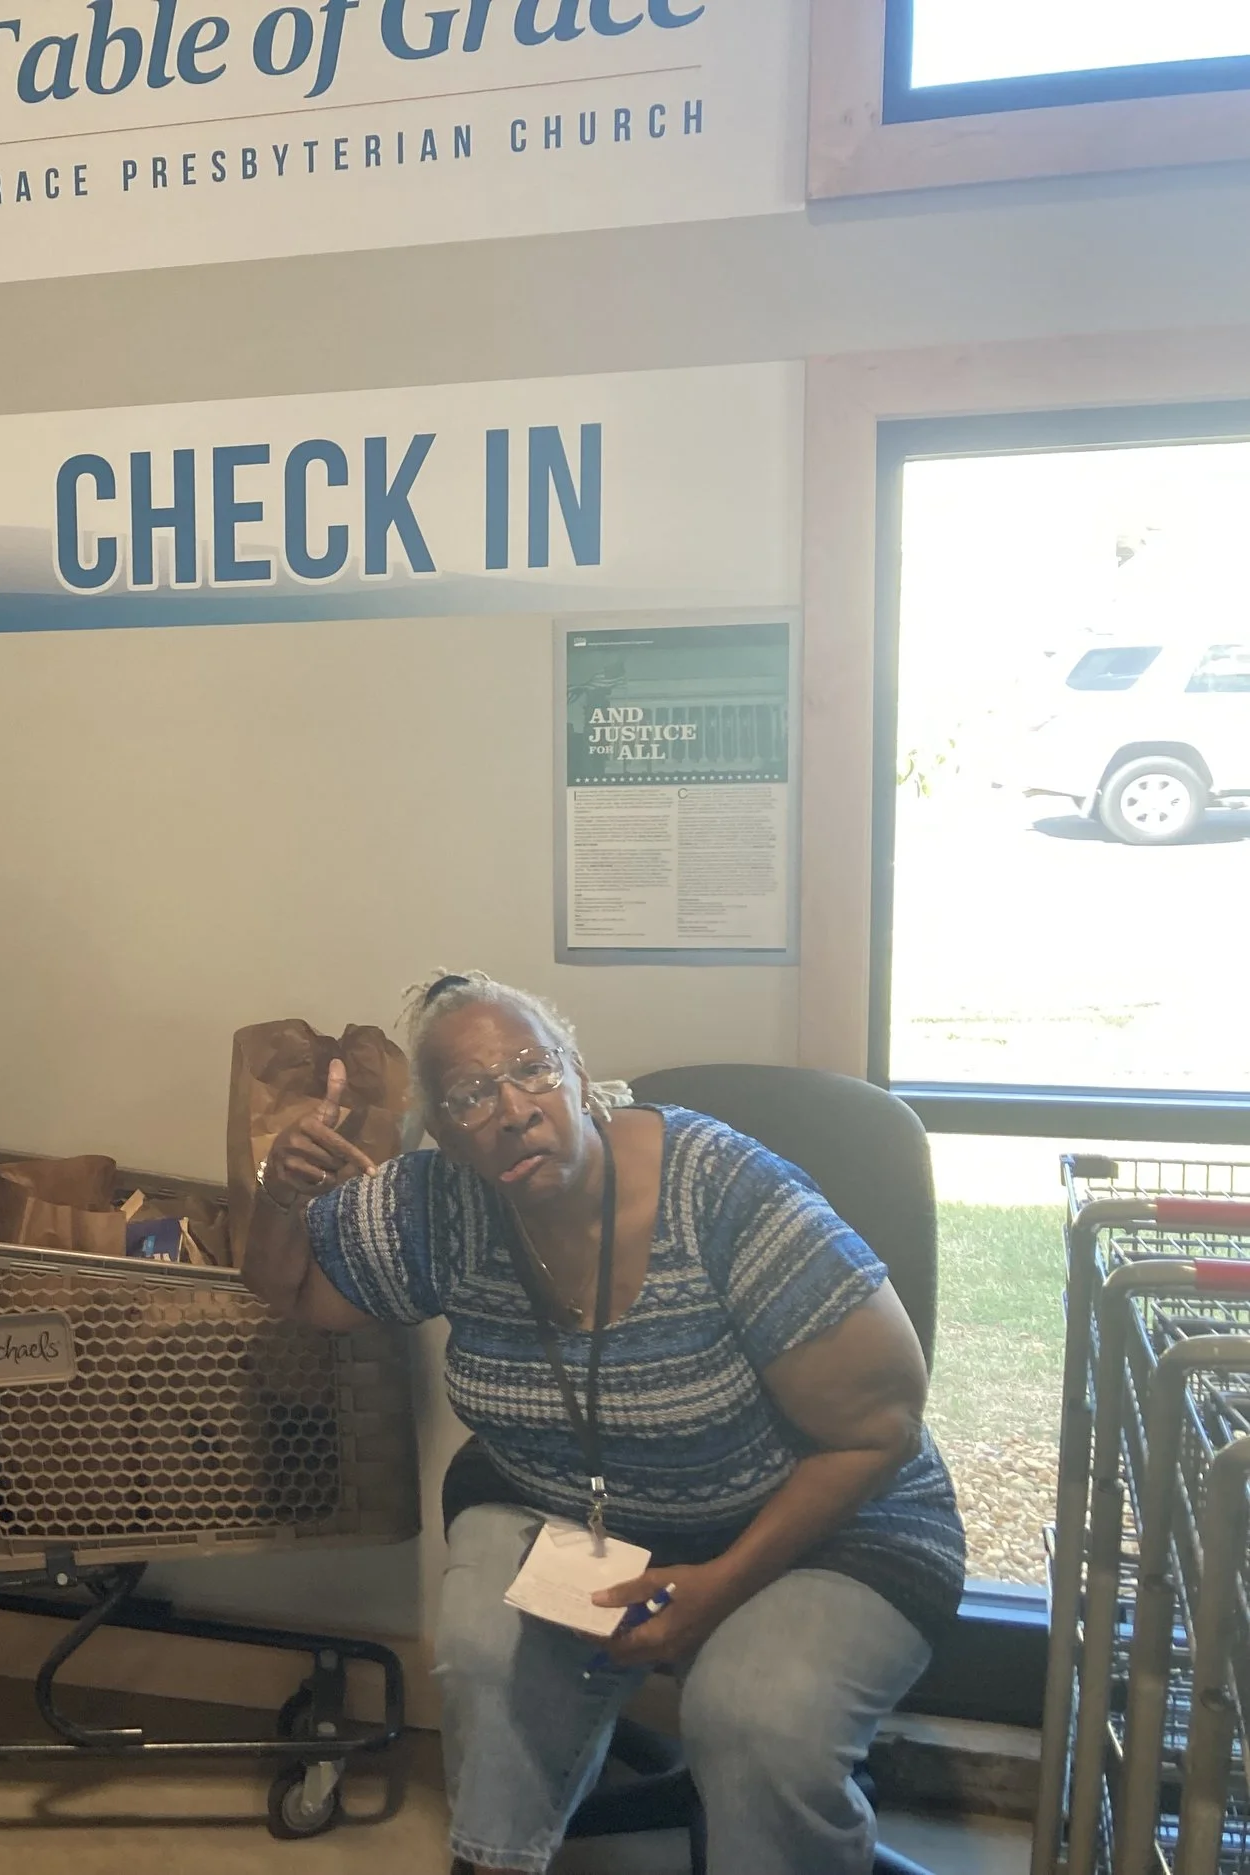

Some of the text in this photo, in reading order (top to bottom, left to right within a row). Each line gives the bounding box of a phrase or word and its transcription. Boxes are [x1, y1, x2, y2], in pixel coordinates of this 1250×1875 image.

[252, 0, 358, 98] of
[122, 125, 471, 191] PRESBYTERIAN
[510, 99, 703, 153] CHURCH
[56, 422, 602, 589] CHECK IN
[588, 707, 644, 724] AND
[588, 724, 697, 743] JUSTICE
[588, 743, 666, 760] FOR ALL
